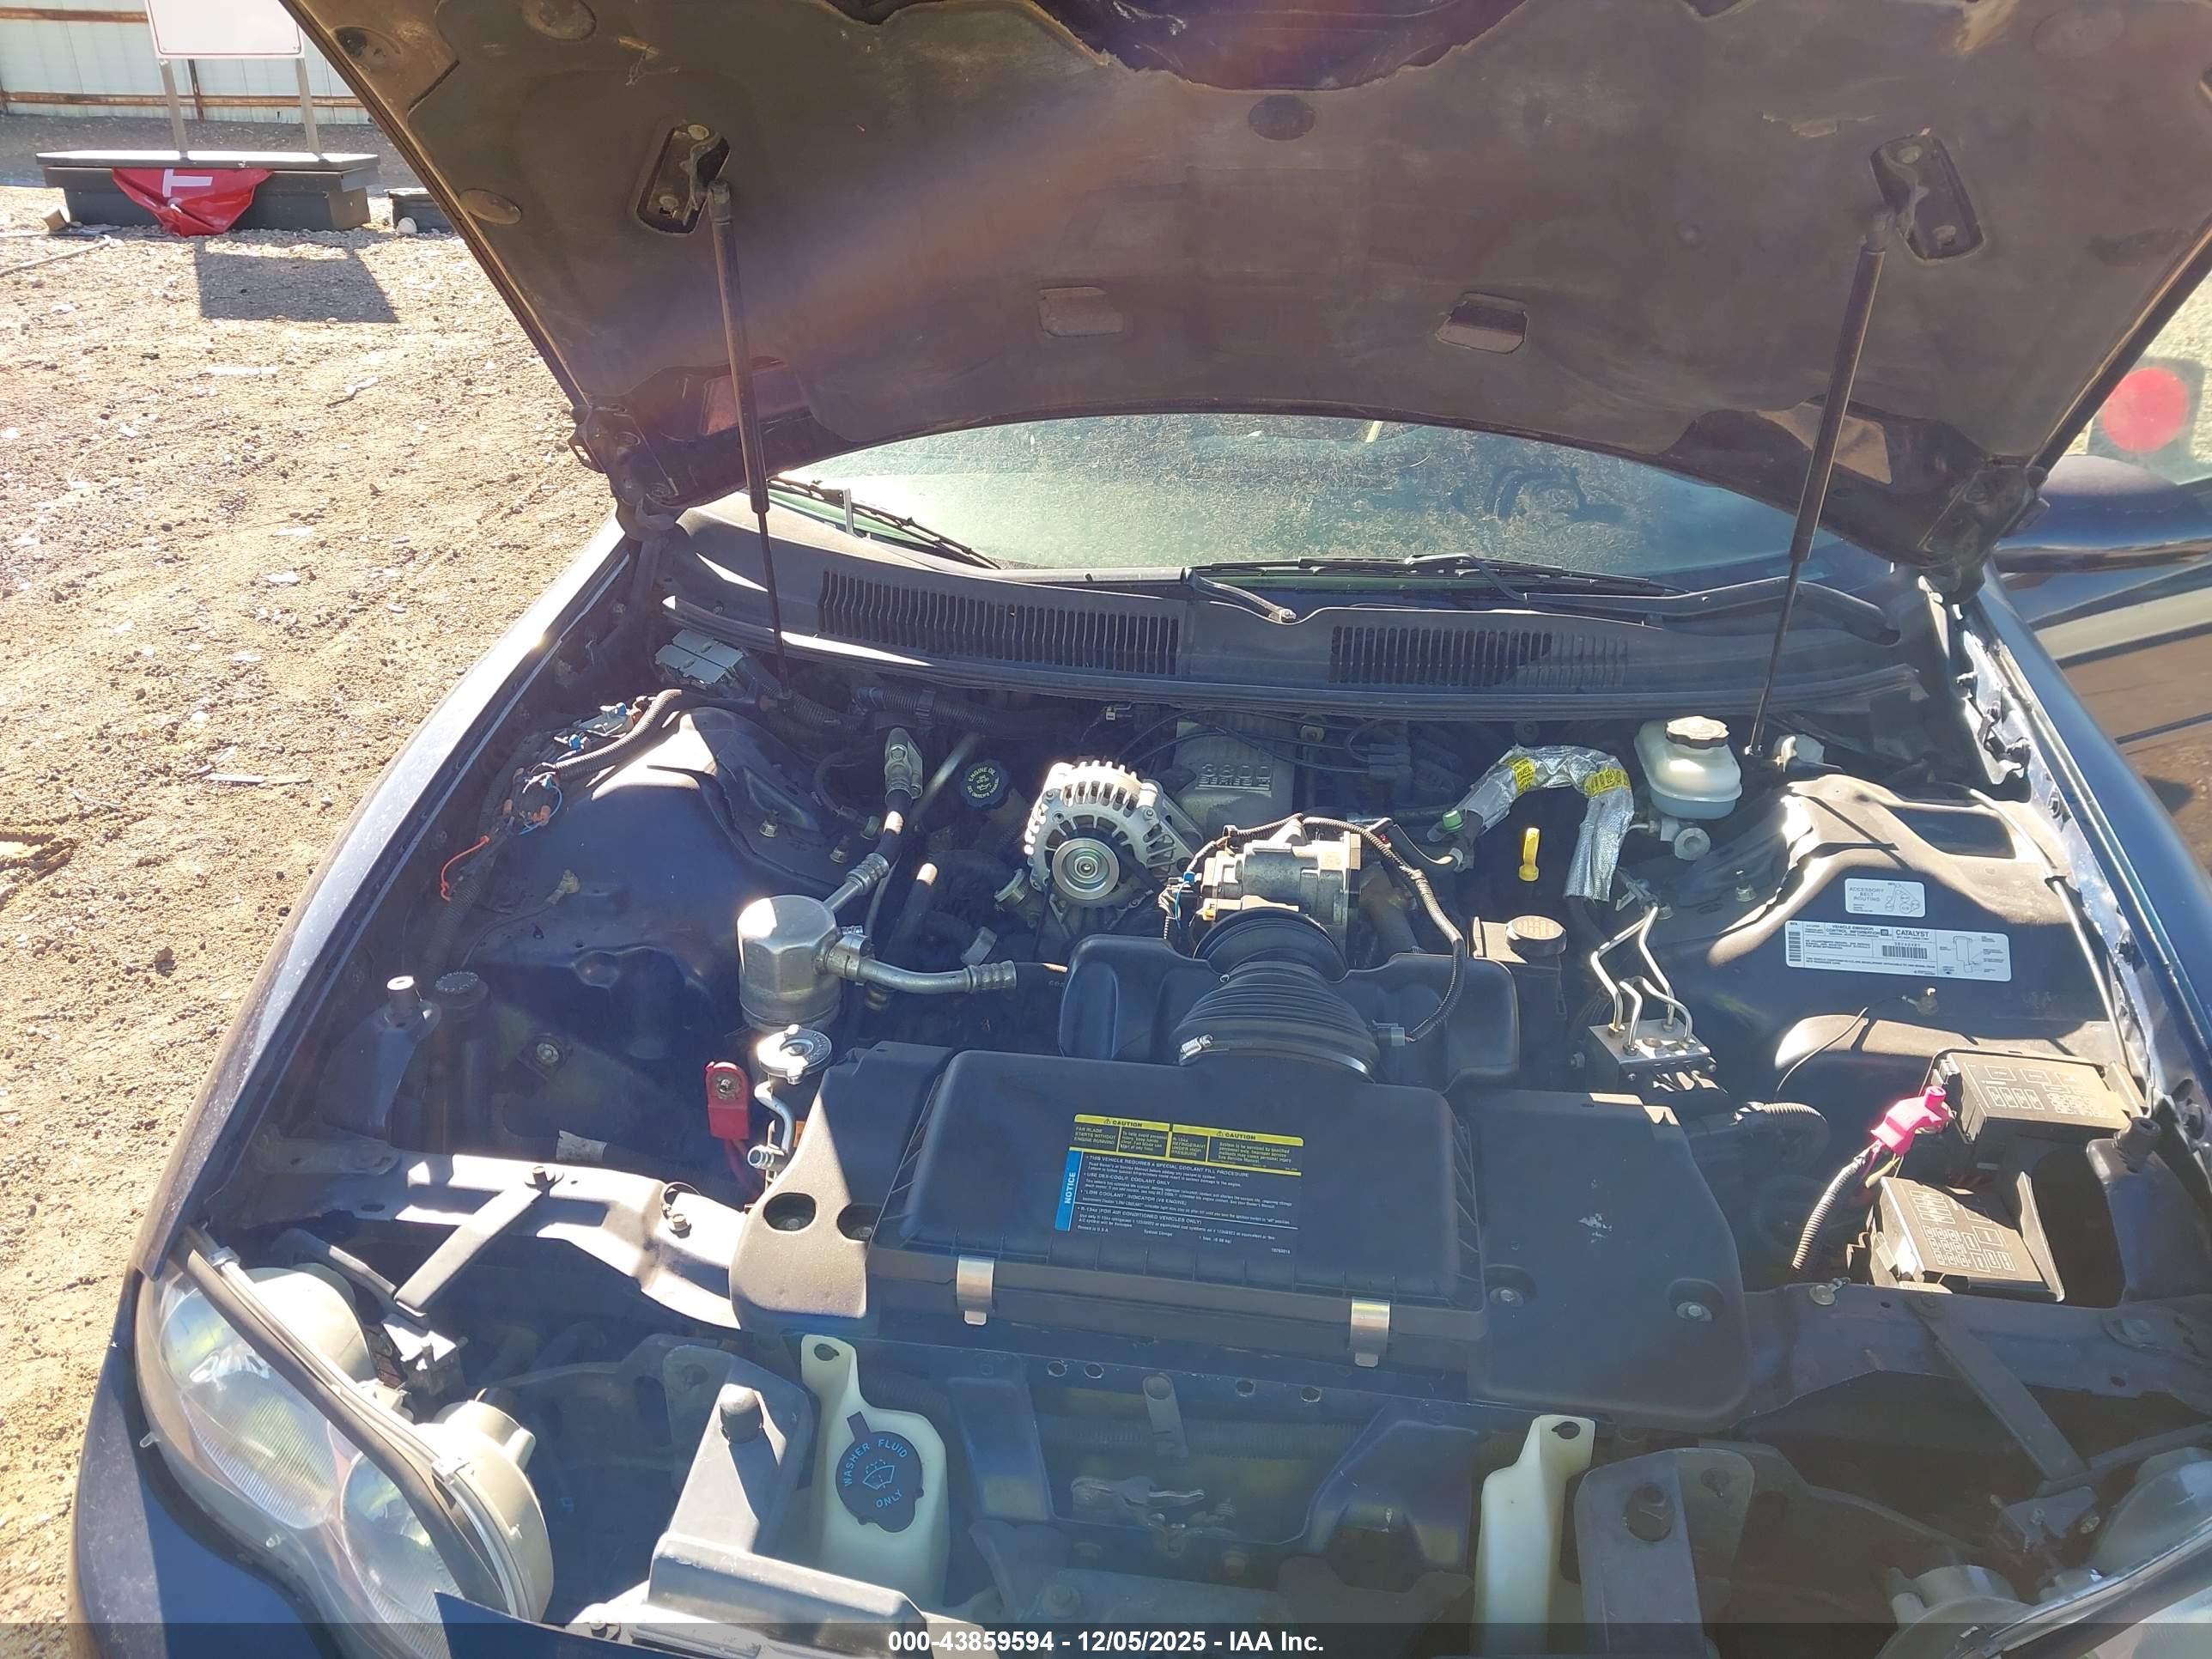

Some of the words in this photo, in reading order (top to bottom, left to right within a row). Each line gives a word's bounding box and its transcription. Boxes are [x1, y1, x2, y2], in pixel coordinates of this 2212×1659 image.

[968, 766, 988, 782] ENGINE
[1065, 1172, 1076, 1204] NOTICE
[1122, 1211, 1158, 1219] CONDITIONED
[844, 1443, 871, 1487] WASHER
[878, 1438, 908, 1457] FLUID
[876, 1489, 902, 1508] ONLY
